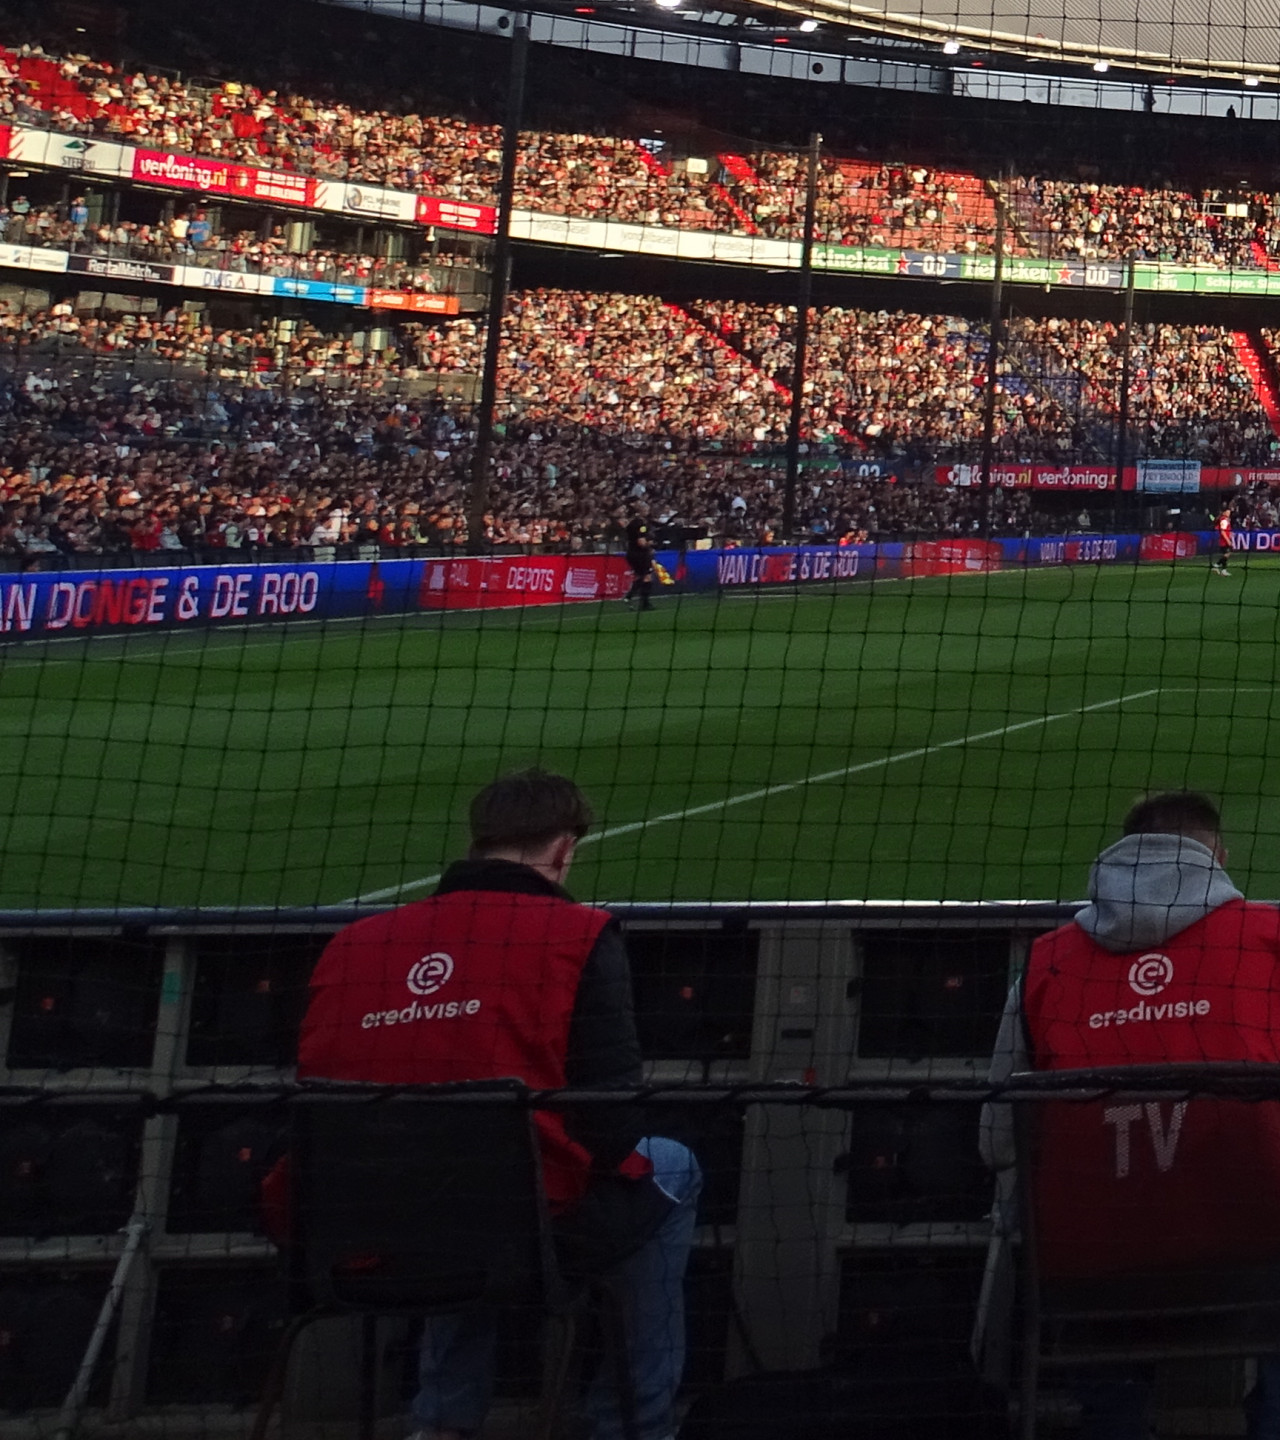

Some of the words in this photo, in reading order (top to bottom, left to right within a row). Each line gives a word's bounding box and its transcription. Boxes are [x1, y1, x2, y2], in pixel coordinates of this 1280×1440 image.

[140, 155, 227, 189] verloning.nl
[506, 566, 554, 592] DEPOTS
[718, 555, 746, 584] VAN
[45, 576, 169, 629] DONGE
[176, 576, 199, 620] &
[209, 573, 252, 618] DE
[259, 571, 319, 614] ROO
[361, 998, 481, 1029] eredivisie
[1089, 998, 1211, 1029] eredivisie
[1102, 1100, 1189, 1179] TV
